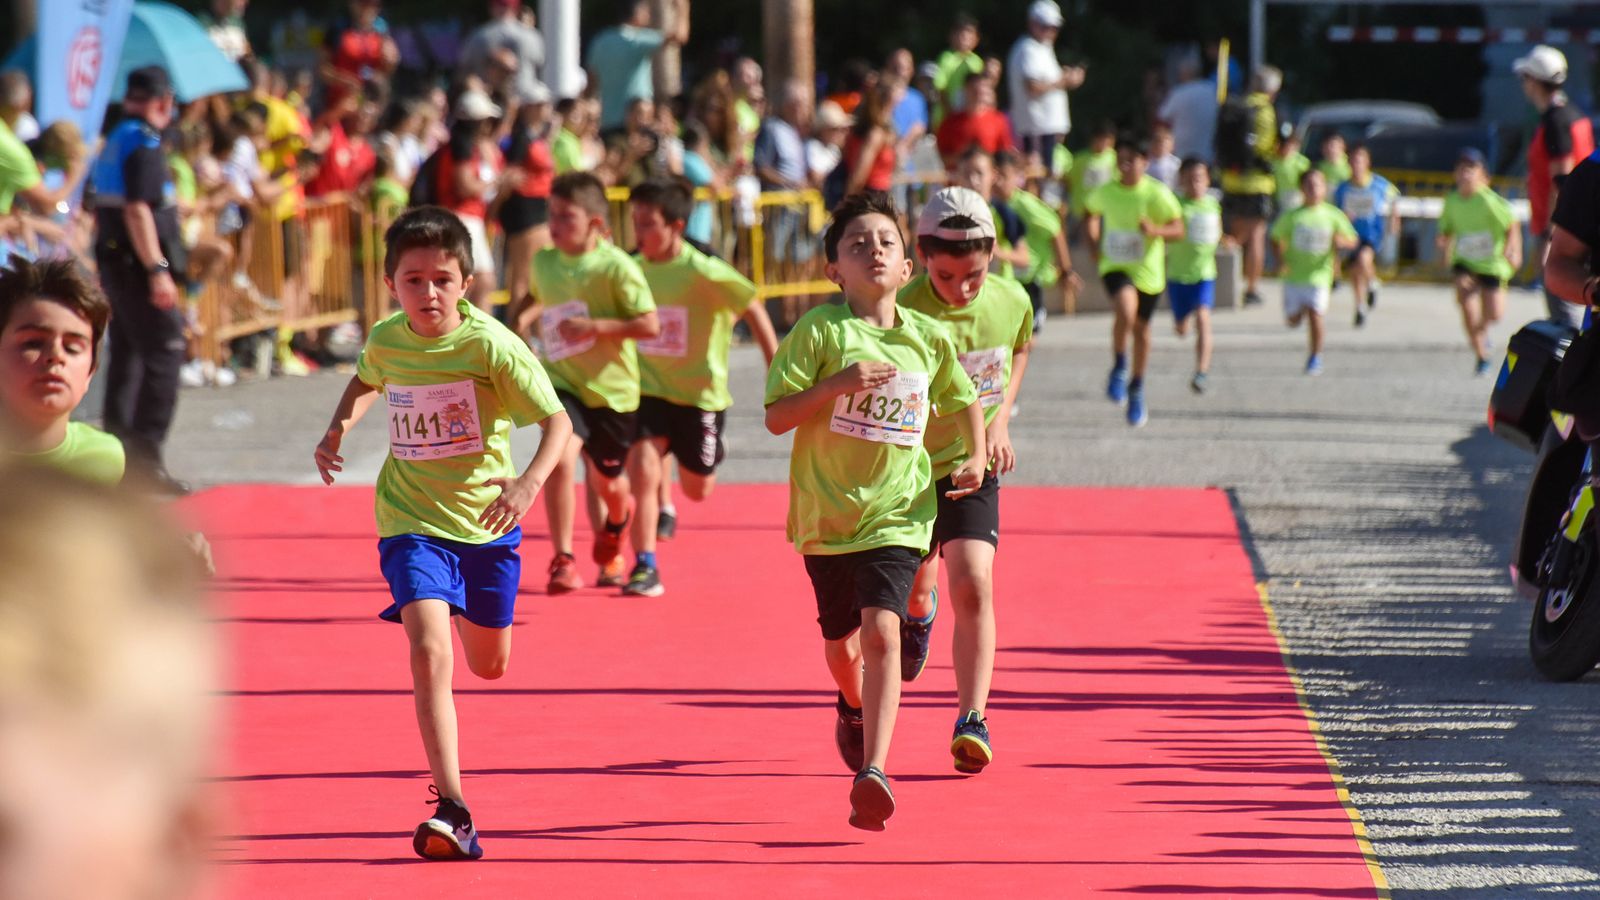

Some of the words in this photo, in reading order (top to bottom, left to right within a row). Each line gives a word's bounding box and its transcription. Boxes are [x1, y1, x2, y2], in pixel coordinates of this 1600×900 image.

[428, 388, 455, 397] SAMUEL
[844, 392, 903, 424] 1432
[392, 411, 441, 439] 1141
